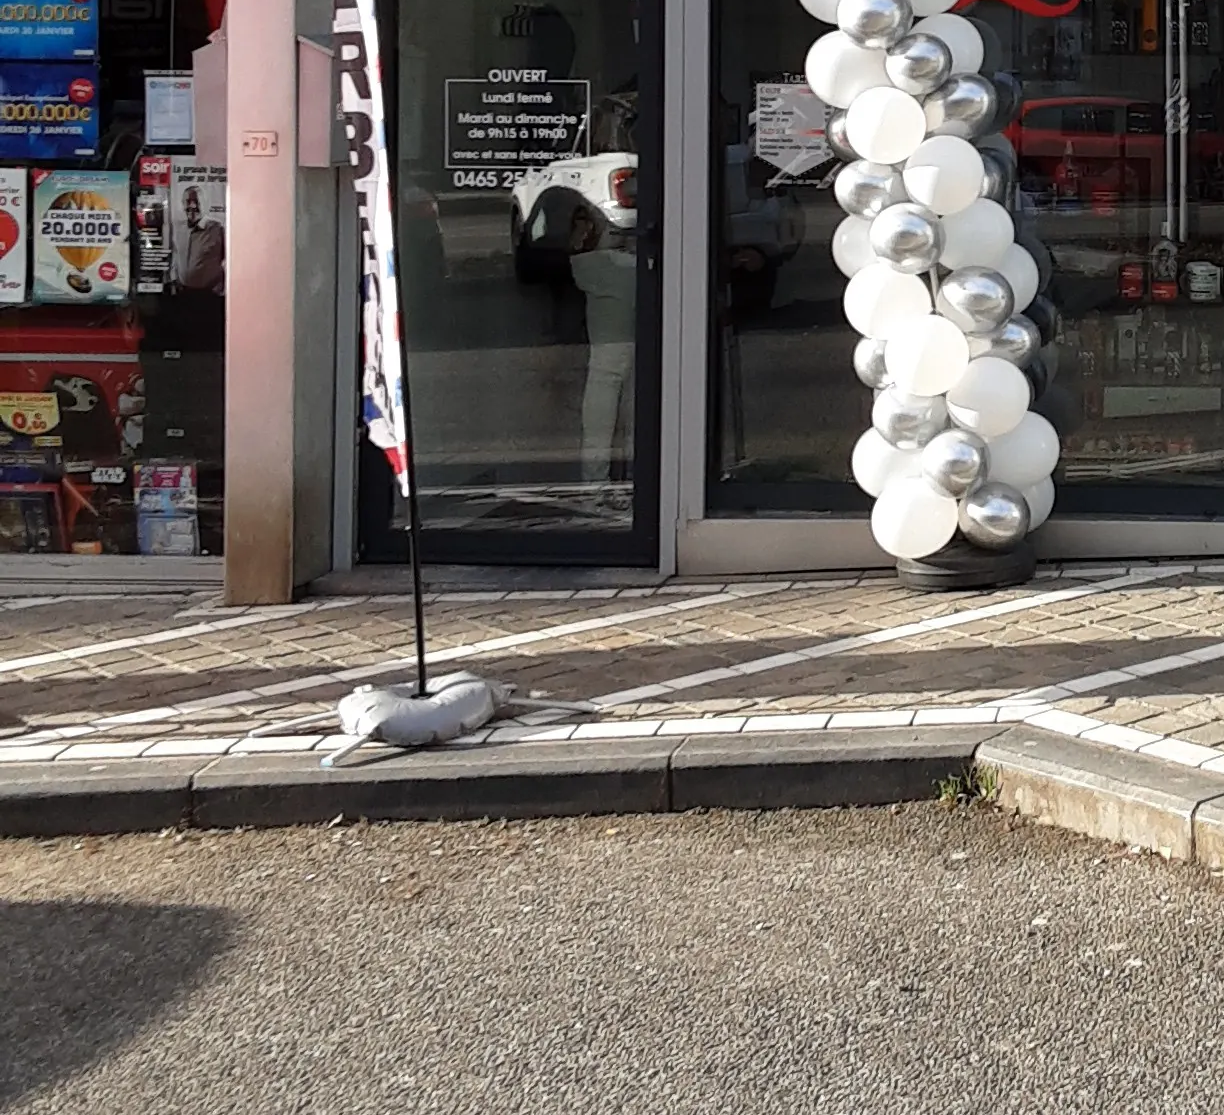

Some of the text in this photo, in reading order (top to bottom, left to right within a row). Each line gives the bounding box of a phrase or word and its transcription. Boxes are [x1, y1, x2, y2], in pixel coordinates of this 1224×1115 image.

[488, 69, 547, 83] OUVERT
[482, 91, 553, 103] Lundi fermé
[457, 113, 577, 124] Mardi au dimanche
[468, 128, 567, 139] de 9h15 à 19h00
[252, 137, 268, 151] 70
[453, 151, 479, 159] avec
[481, 150, 492, 159] et
[494, 151, 517, 159] sans
[142, 159, 171, 174] soir
[453, 171, 498, 187] 0465
[42, 222, 121, 235] 20.000€
